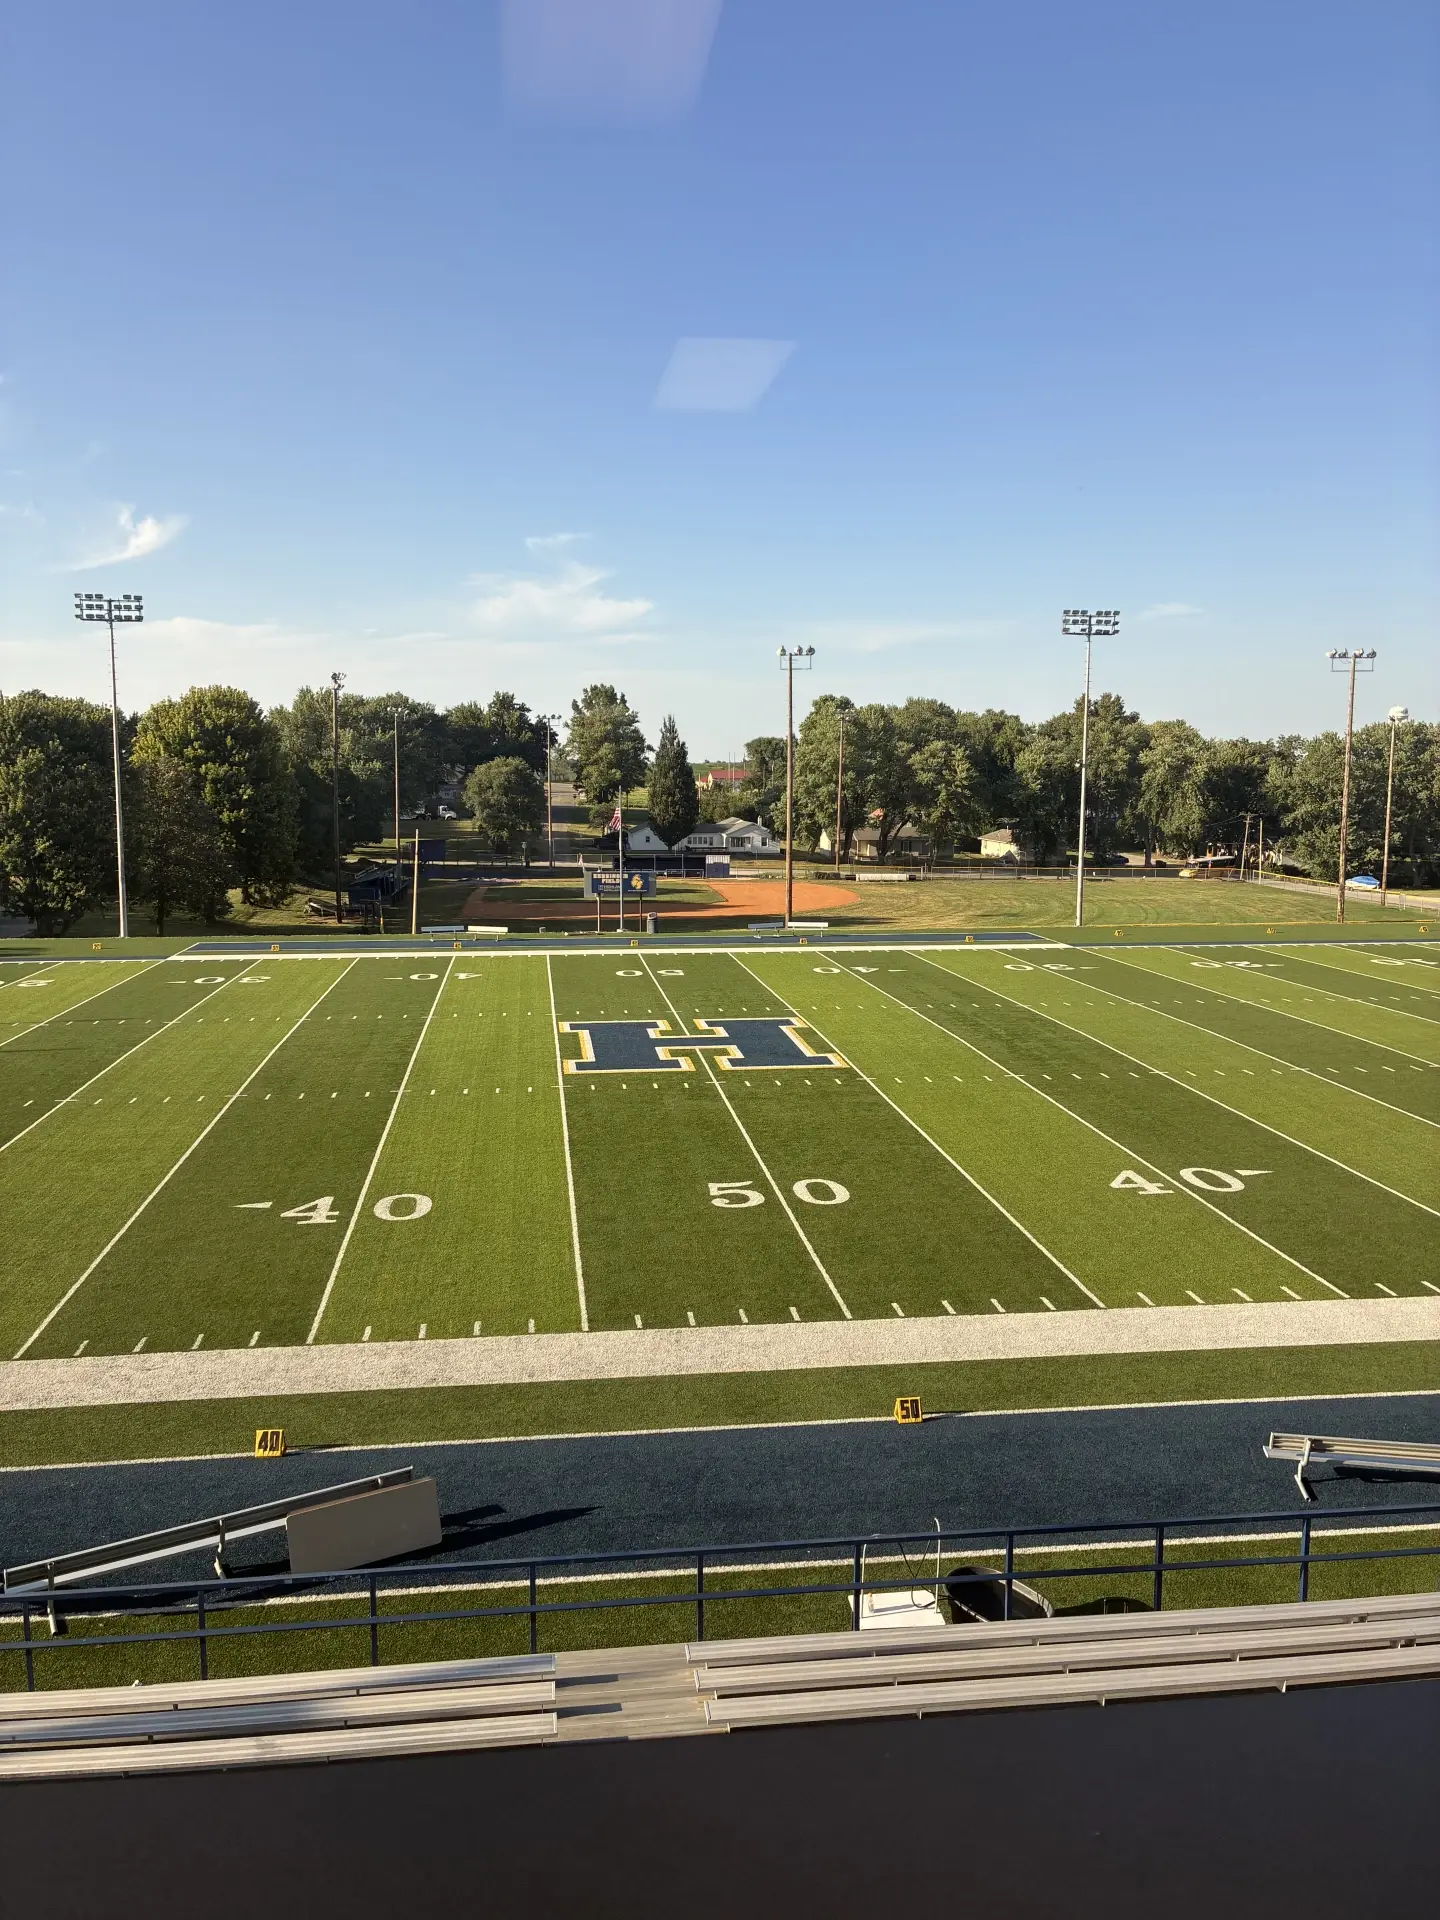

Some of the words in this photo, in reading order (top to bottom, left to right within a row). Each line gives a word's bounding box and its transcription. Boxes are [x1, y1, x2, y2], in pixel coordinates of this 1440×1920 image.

[707, 1178, 850, 1208] 50
[1110, 1167, 1245, 1195] 40
[280, 1193, 433, 1225] 40
[899, 1399, 920, 1419] 50
[258, 1430, 281, 1452] 40
